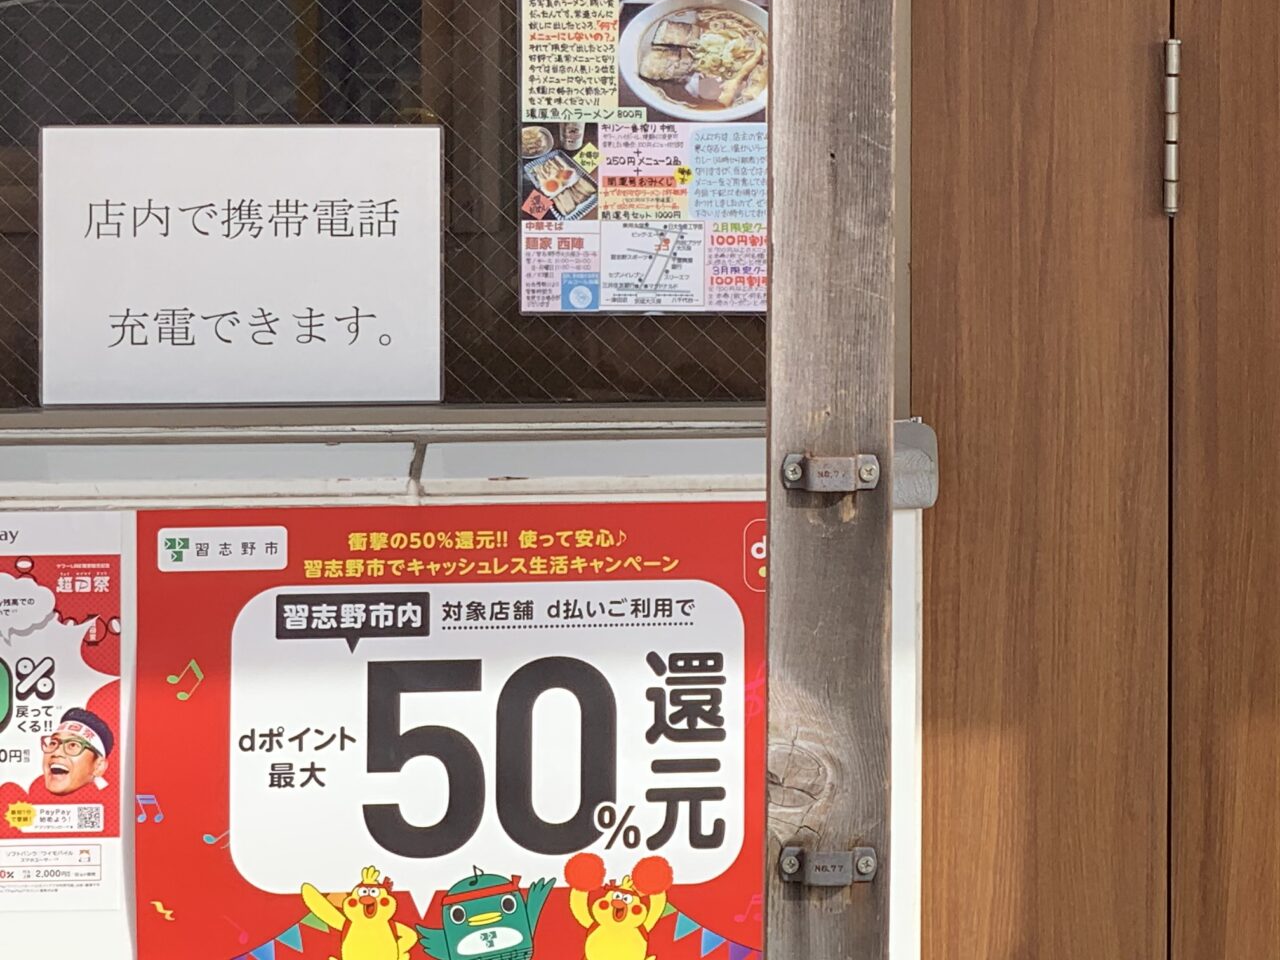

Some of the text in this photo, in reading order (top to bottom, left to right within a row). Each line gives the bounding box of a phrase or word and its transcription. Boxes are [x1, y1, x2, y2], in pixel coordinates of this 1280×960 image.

[84, 198, 400, 240] 店内で携帯電話
[107, 305, 393, 348] 充電できます。
[194, 540, 279, 558] 習志野市
[348, 530, 509, 552] 衝撃の50%還元!!
[304, 554, 680, 579] 習志野市でキャッシュレス生活キャンペーン
[283, 602, 424, 632] 習志野市内
[441, 598, 696, 623] 対象店舗 d払いご利用で
[16, 705, 54, 718] 戻って
[17, 720, 52, 732] くる!!
[239, 726, 357, 753] dポイント
[645, 651, 727, 852] 還元
[268, 762, 326, 789] 最大
[40, 808, 71, 816] PayPay
